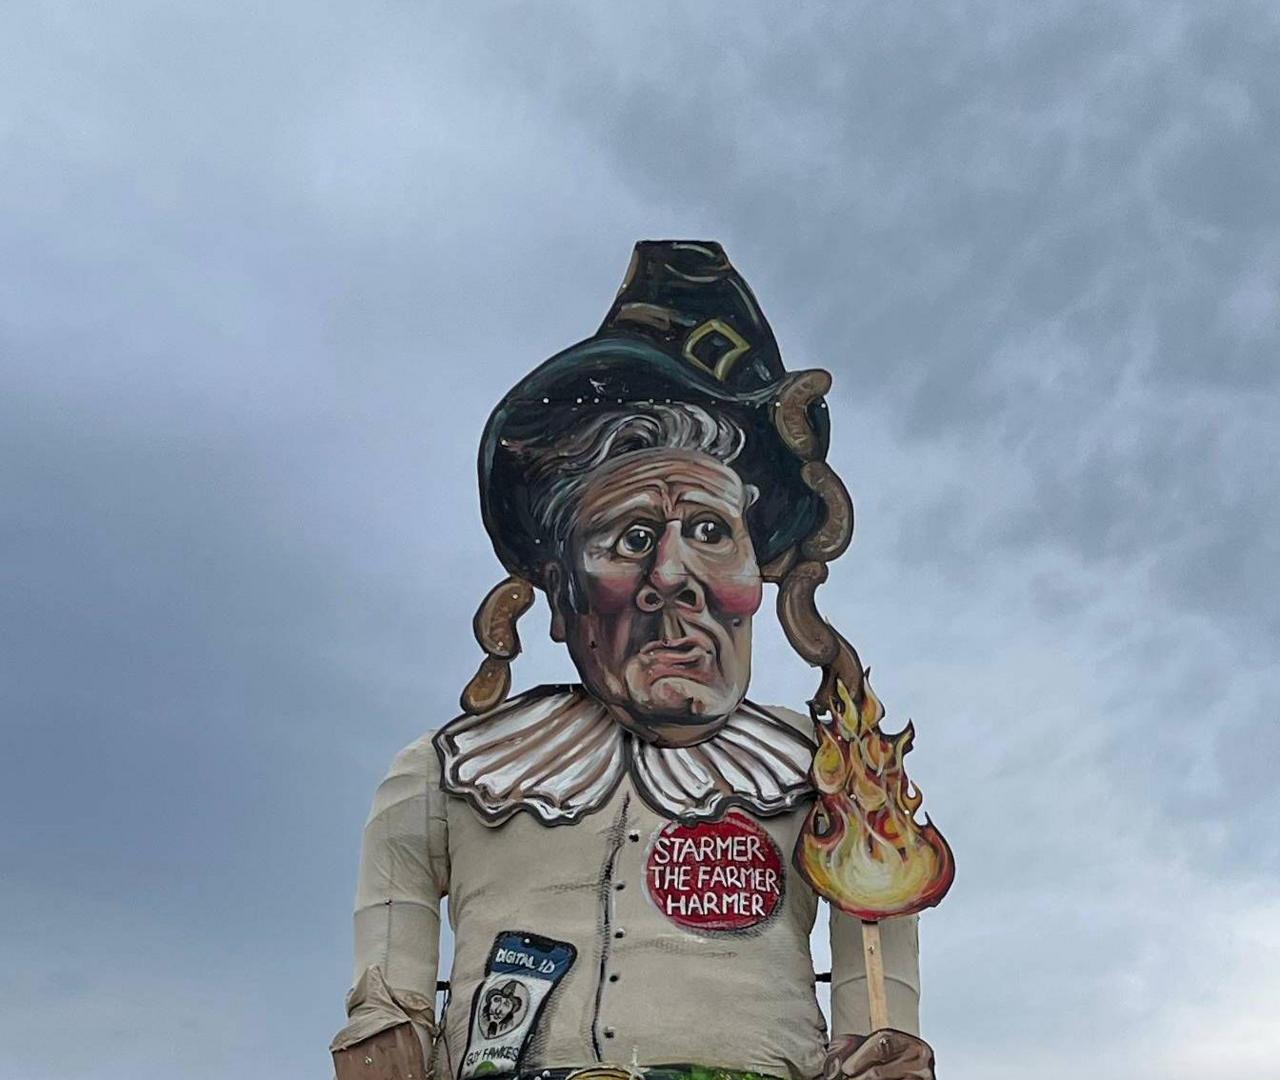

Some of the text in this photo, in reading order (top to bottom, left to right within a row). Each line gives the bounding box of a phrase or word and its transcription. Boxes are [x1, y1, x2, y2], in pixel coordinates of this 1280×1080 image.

[654, 835, 766, 864] STARMER
[649, 866, 780, 895] THE FARMER
[666, 892, 766, 917] HARMER
[495, 948, 556, 974] DIGITAL ID
[482, 1045, 519, 1062] FAWKES
